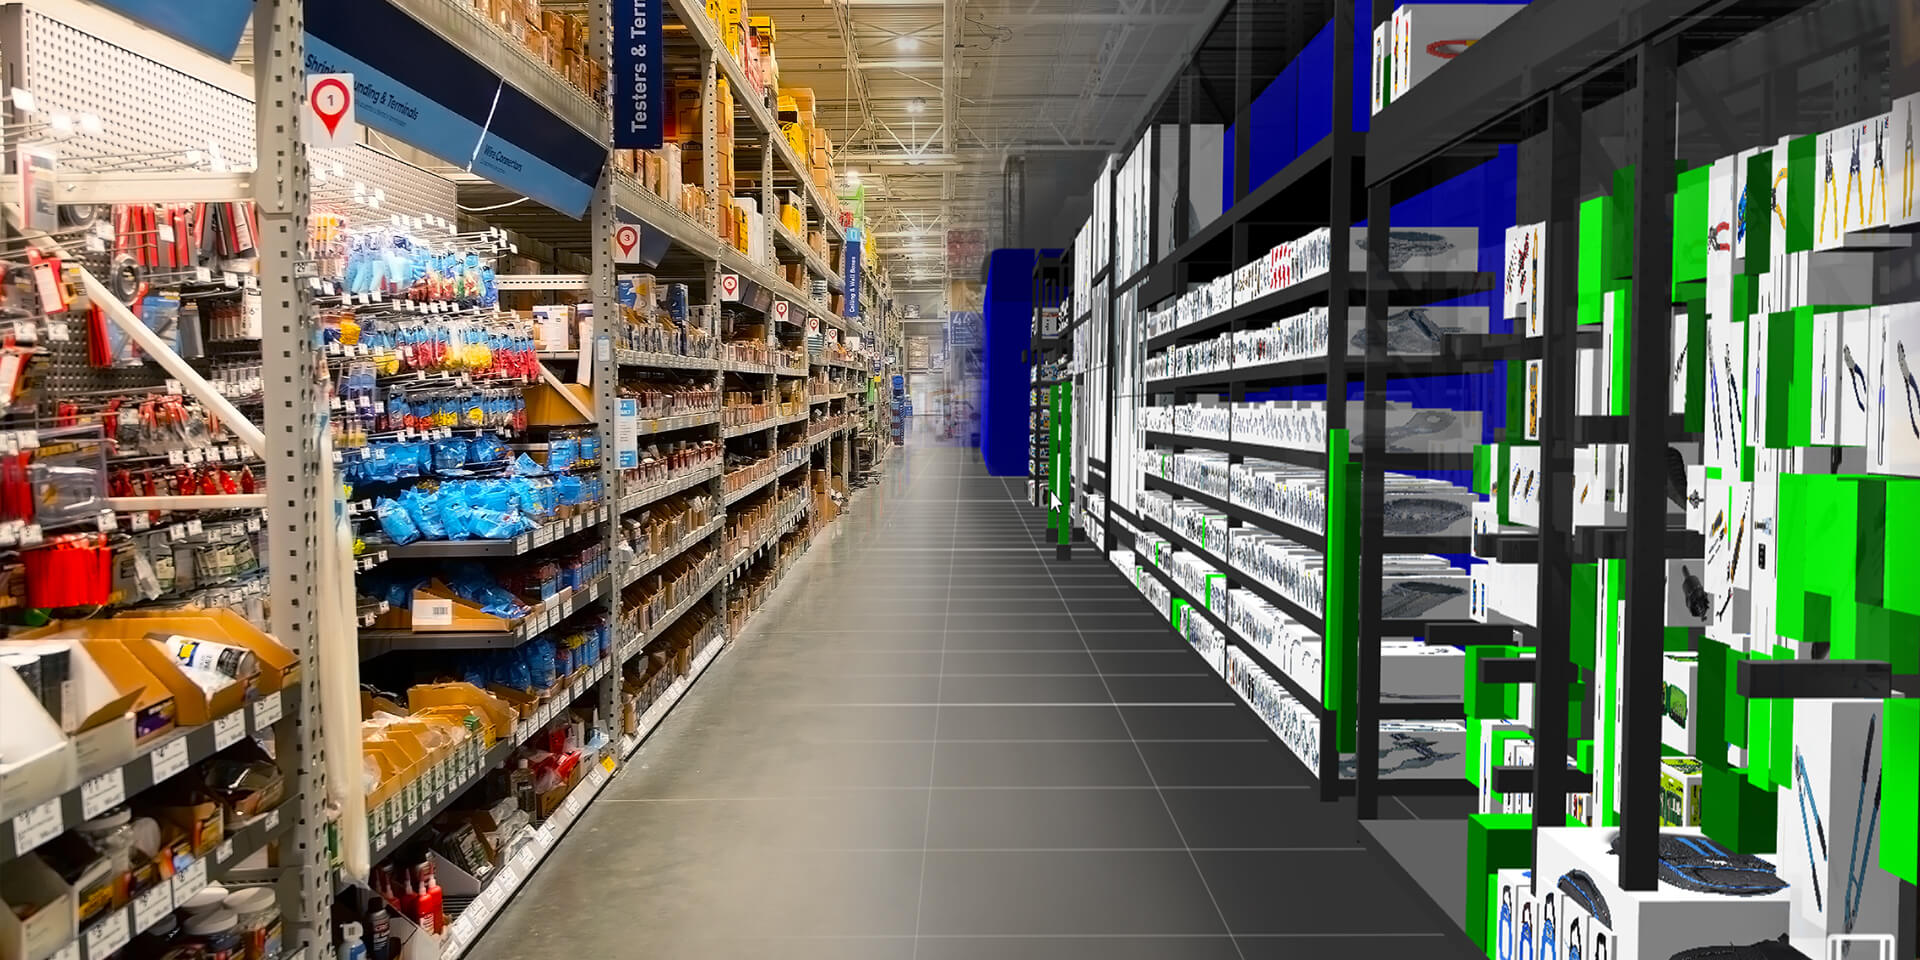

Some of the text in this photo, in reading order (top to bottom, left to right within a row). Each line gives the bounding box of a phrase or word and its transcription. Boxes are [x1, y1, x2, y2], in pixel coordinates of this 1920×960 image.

[631, 44, 646, 57] &
[327, 94, 334, 106] 1
[631, 63, 647, 133] Testers
[380, 92, 387, 104] &
[388, 95, 419, 121] Terminals
[624, 234, 631, 242] 3
